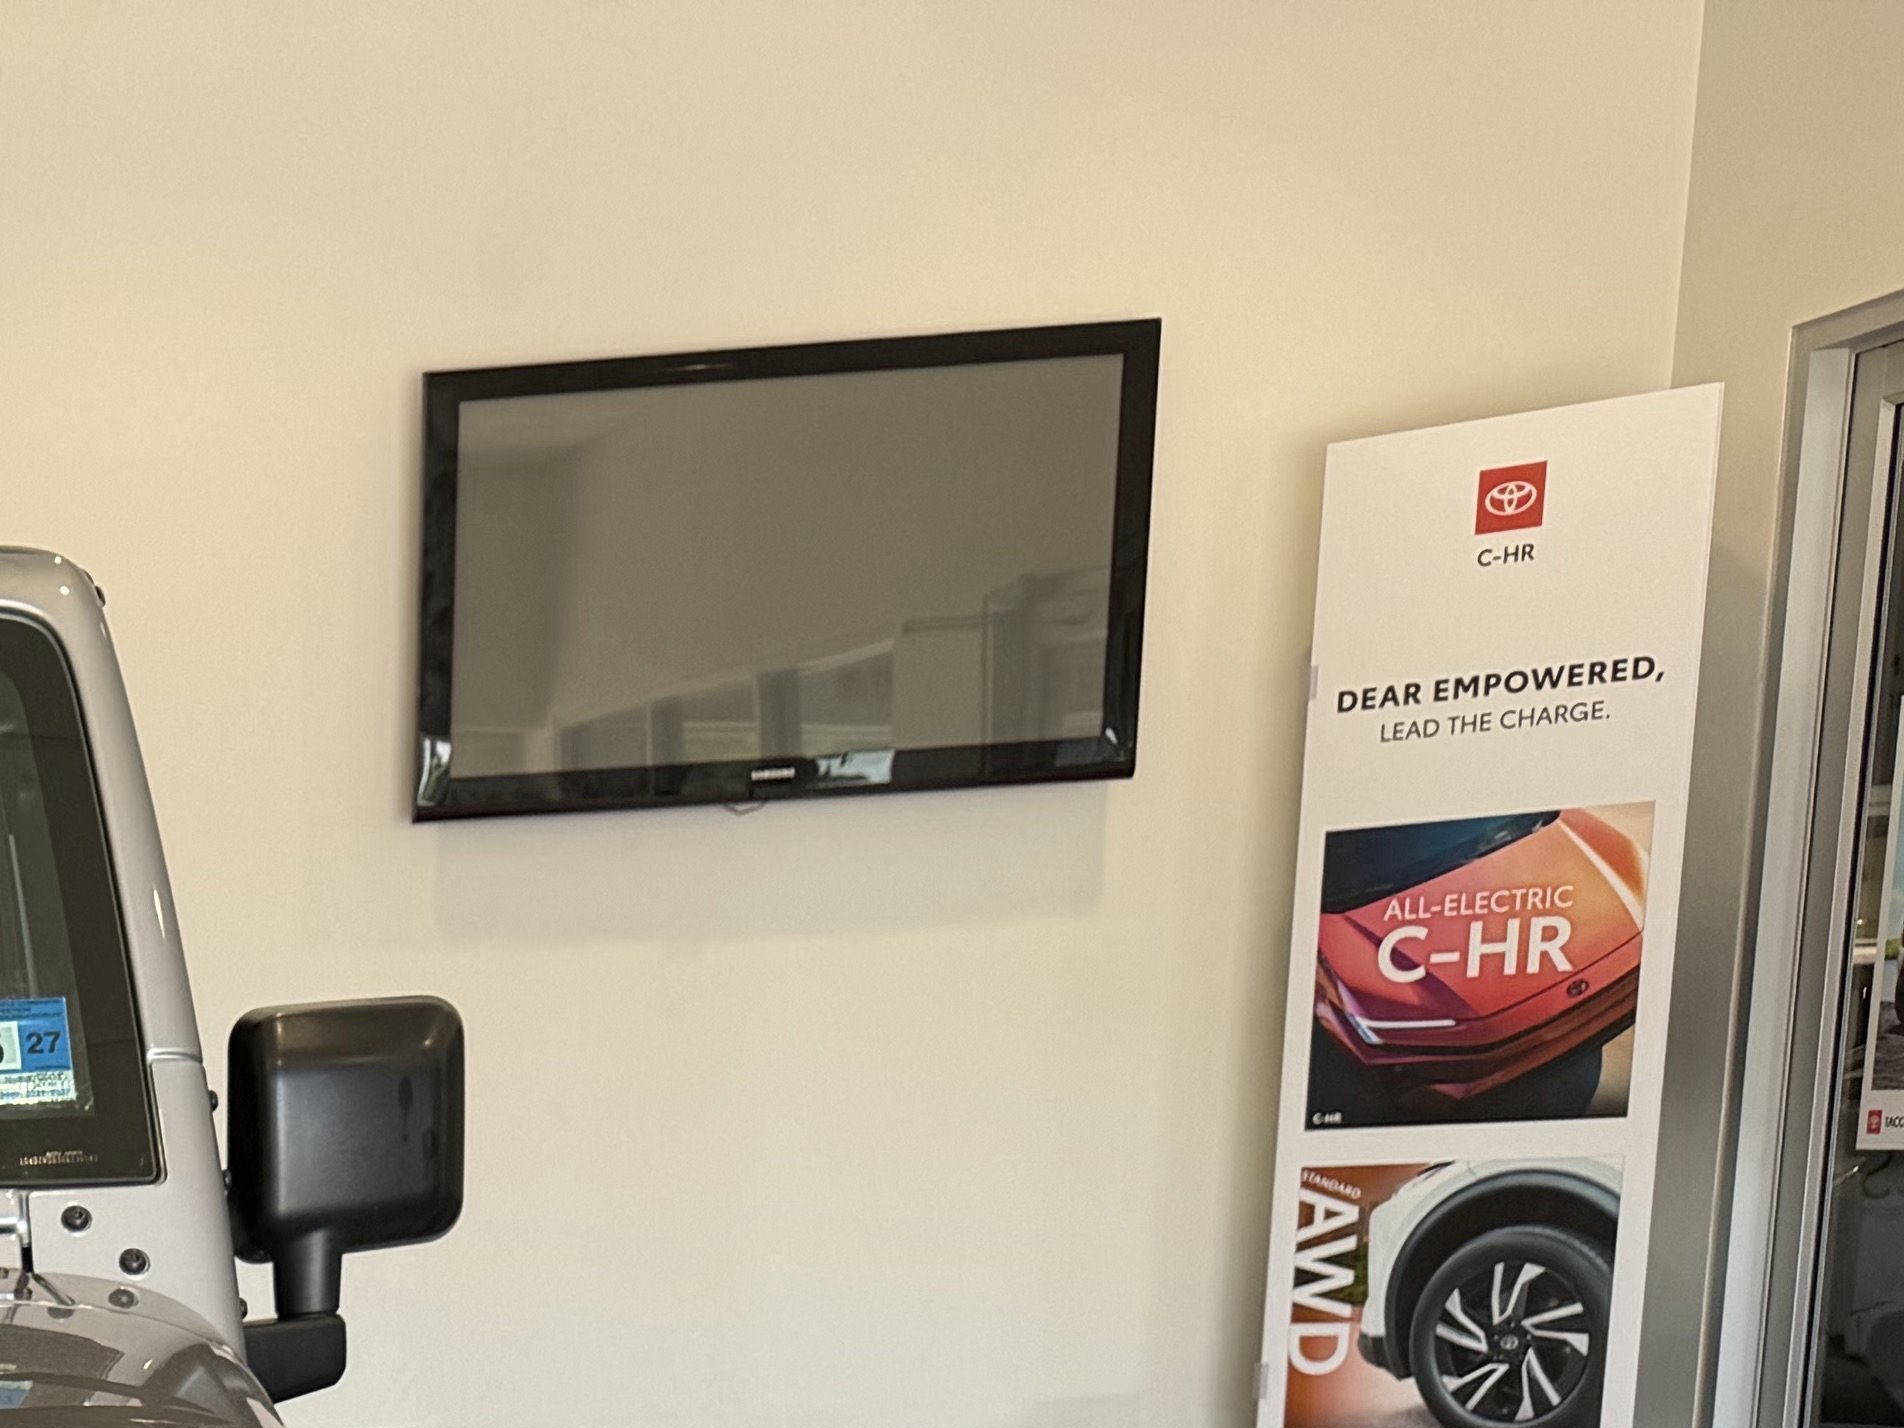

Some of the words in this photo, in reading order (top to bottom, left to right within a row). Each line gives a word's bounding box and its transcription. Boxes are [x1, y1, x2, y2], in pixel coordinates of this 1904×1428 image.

[1477, 543, 1535, 567] C-HR
[1336, 682, 1422, 714] DEAR
[1433, 655, 1665, 704] EMPOWERED,
[1379, 718, 1440, 743] LEAD
[1446, 711, 1492, 735] THE
[1499, 700, 1611, 730] CHARGE.
[1383, 884, 1574, 922] ALL-ELECTRIC
[1377, 915, 1574, 984] C-HR
[25, 1031, 61, 1054] 27
[1288, 1188, 1360, 1376] AWD
